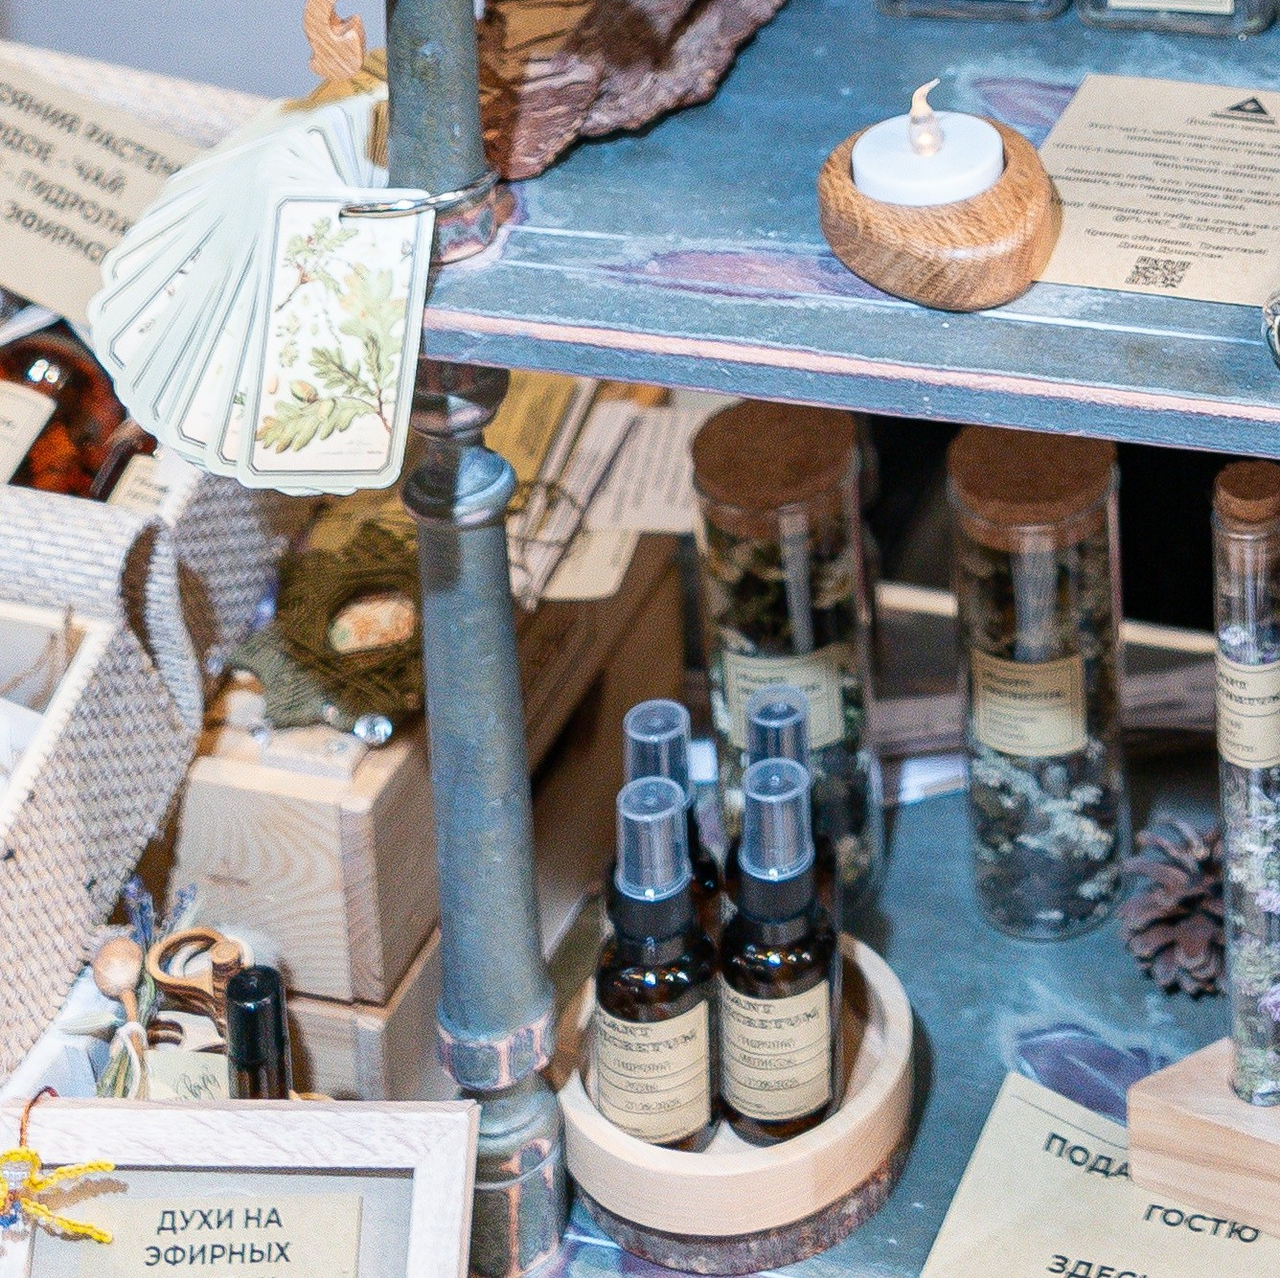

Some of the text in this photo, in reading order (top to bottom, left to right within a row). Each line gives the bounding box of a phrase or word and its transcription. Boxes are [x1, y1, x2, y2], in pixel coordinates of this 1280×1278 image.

[156, 1207, 283, 1235] ДУХИ НА
[1143, 1202, 1261, 1245] ГОСТЮ
[144, 1241, 292, 1266] ЭФИРНЫХ
